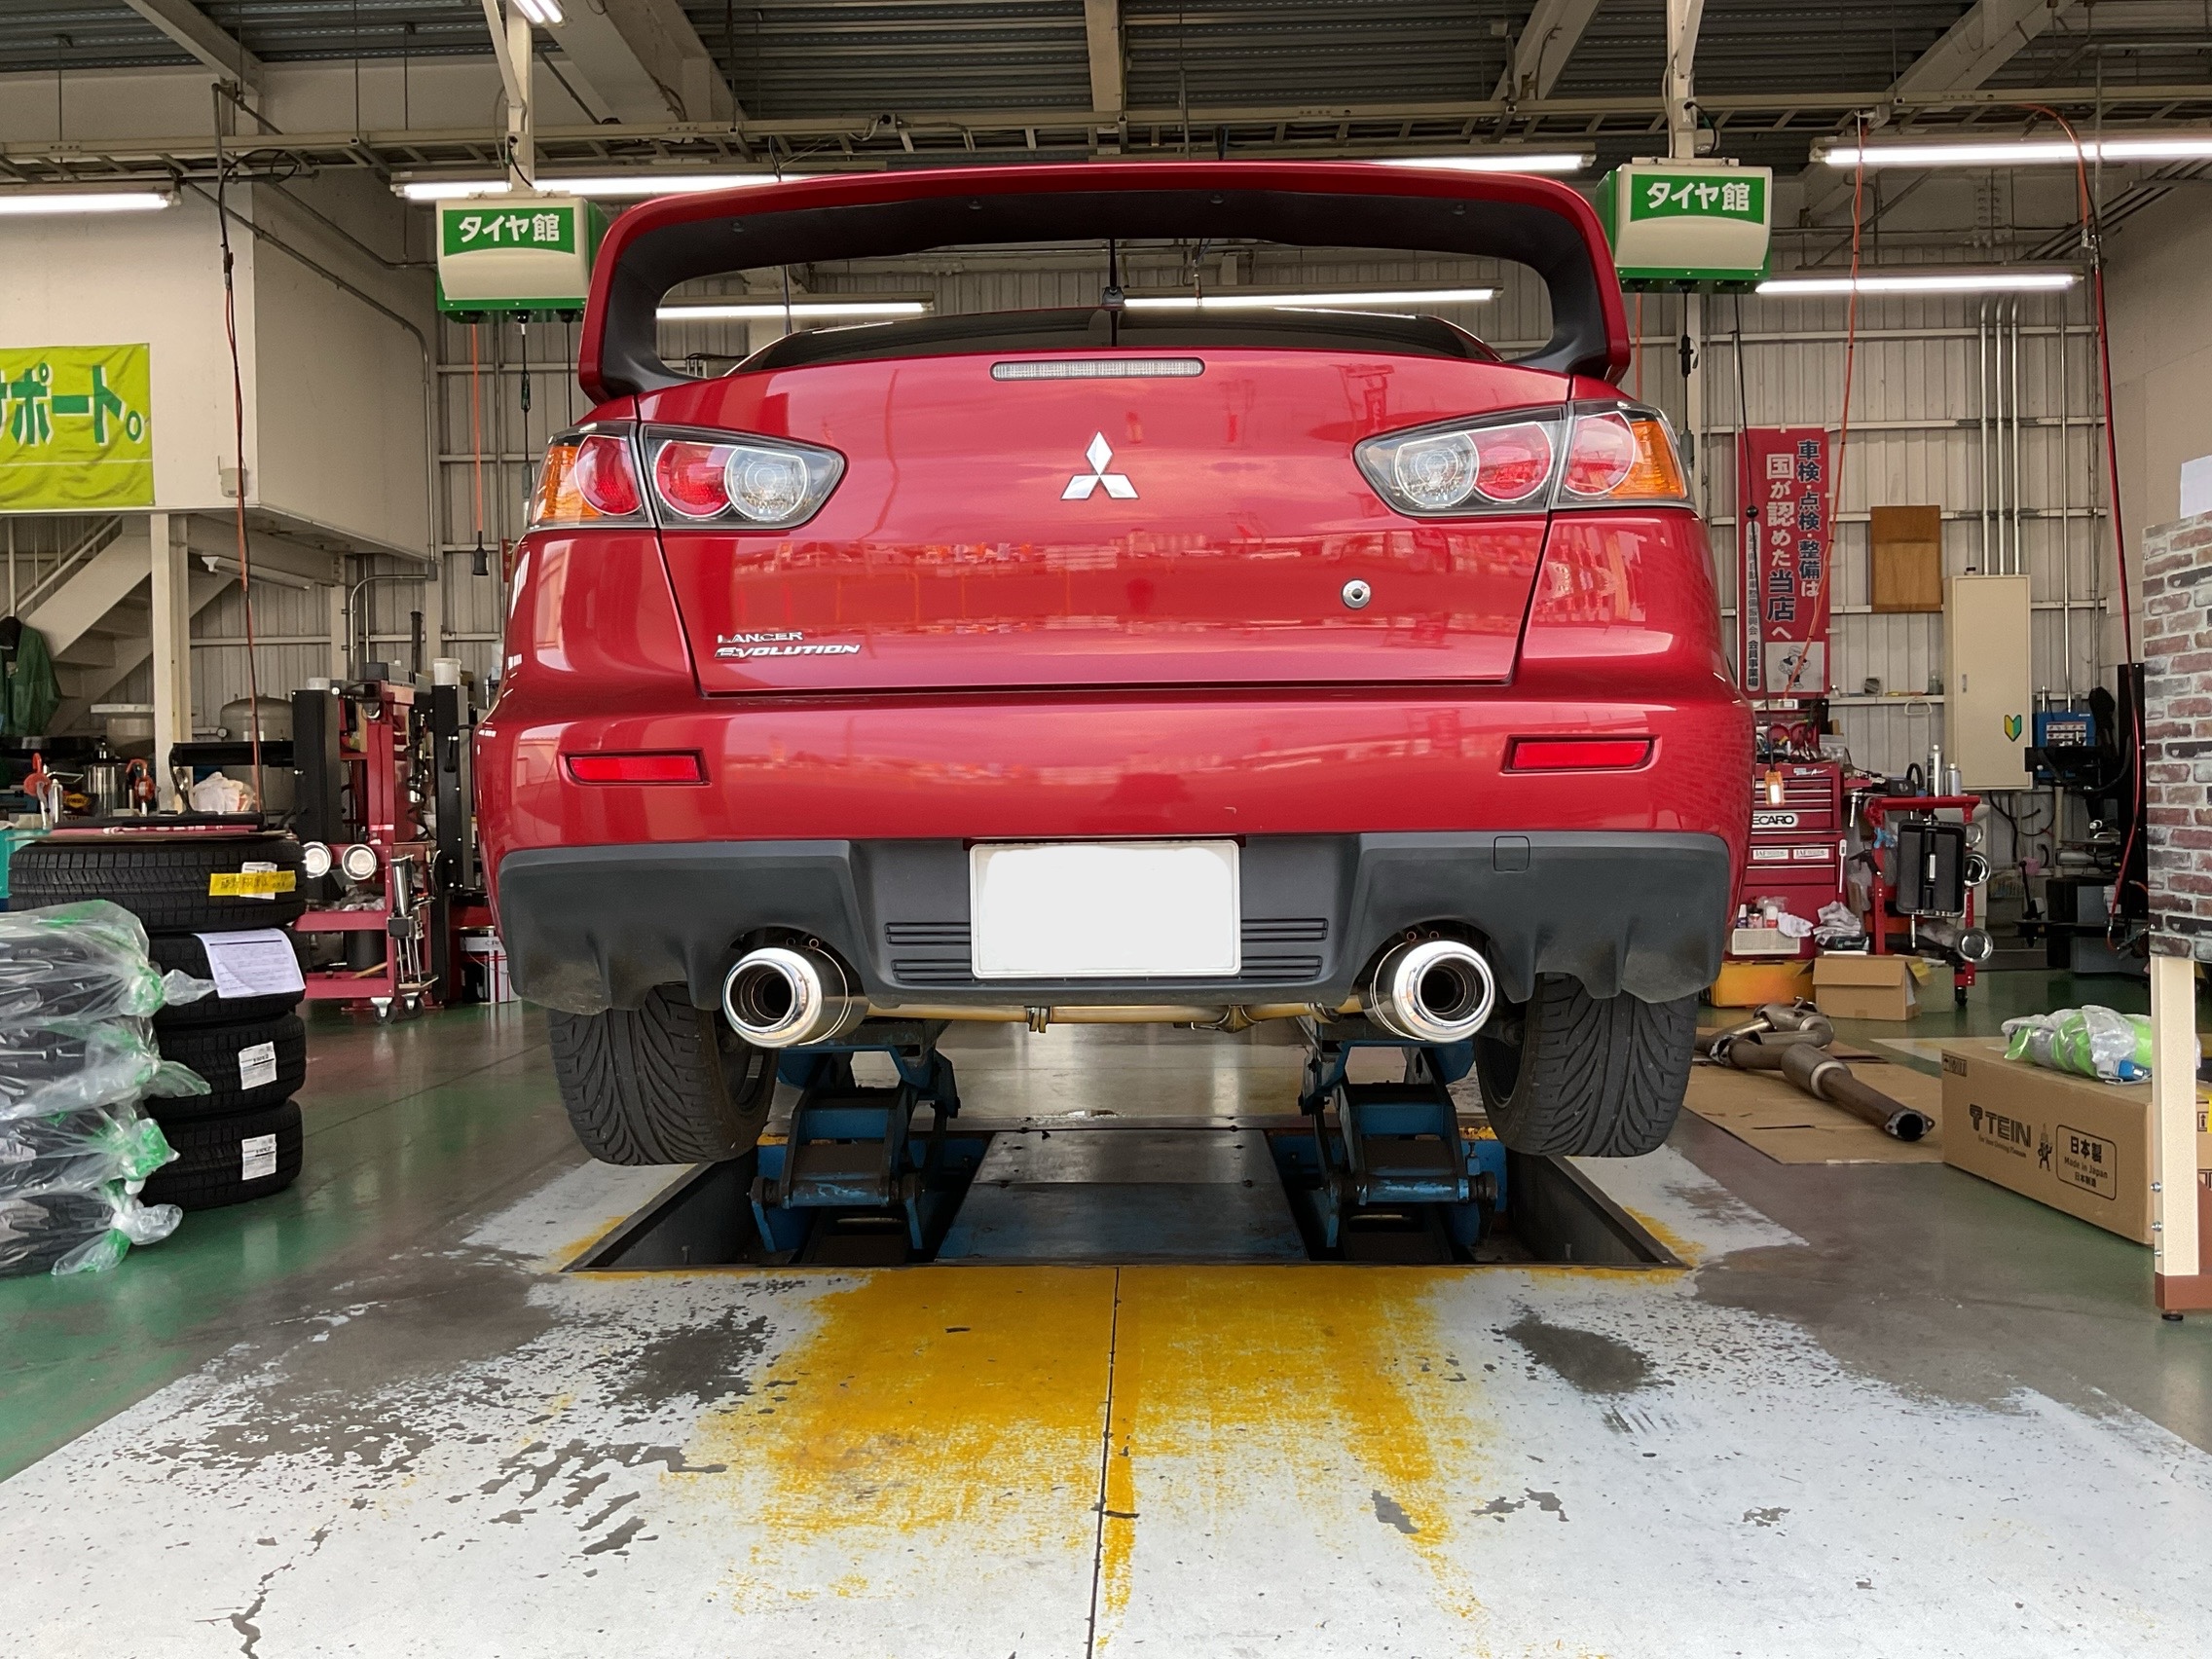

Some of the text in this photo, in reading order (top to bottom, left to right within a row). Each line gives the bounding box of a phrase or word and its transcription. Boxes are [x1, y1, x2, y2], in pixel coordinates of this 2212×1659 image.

[1646, 182, 1751, 211] タイヤ館
[459, 213, 560, 242] タイヤ館
[0, 361, 145, 447] ポート。
[1766, 454, 1795, 641] 国が認めた当店へ
[715, 644, 861, 659] EVOLUTION
[717, 632, 804, 645] LANCER
[1752, 815, 1794, 826] ECARO
[1984, 1110, 2032, 1149] TEIN
[2070, 1135, 2103, 1164] 日本製
[2064, 1156, 2109, 1180] Made in Japan
